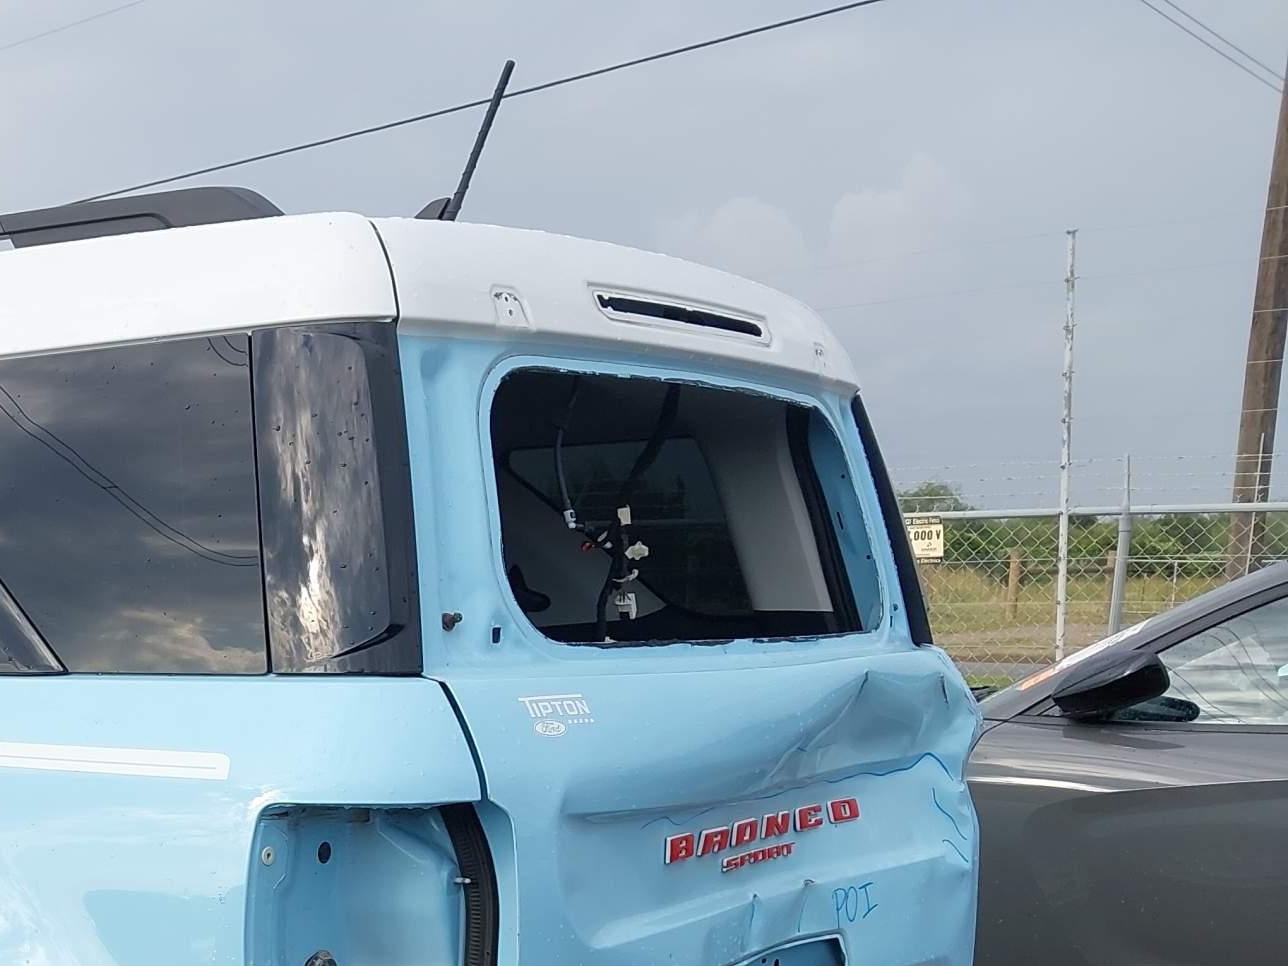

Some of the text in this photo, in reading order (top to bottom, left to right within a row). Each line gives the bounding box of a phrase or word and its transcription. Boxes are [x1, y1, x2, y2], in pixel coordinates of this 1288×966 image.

[935, 530, 941, 540] V
[518, 693, 592, 718] TIPTON
[664, 796, 861, 865] BRONCO
[721, 841, 796, 873] SPORT
[831, 881, 879, 928] POI
